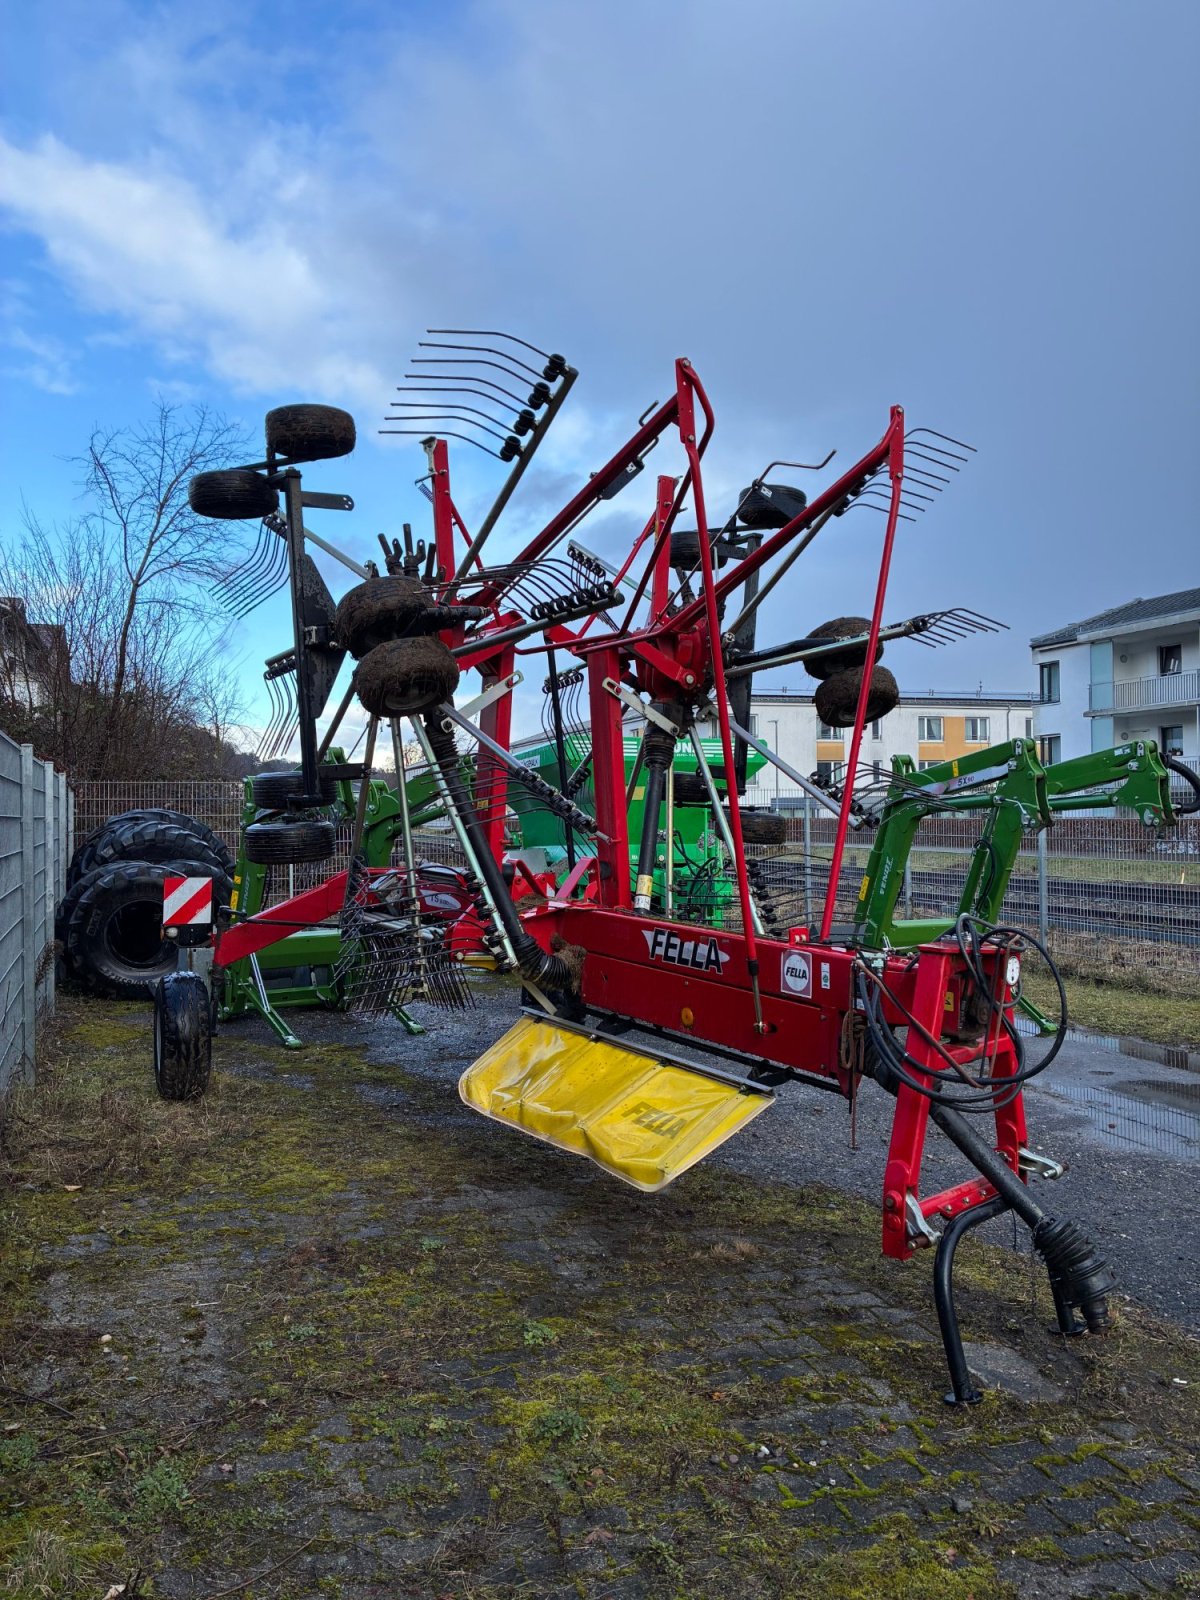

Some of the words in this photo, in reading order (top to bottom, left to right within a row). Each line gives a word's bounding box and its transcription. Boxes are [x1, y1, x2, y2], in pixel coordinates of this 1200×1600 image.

[649, 927, 723, 975] FELLA
[785, 966, 808, 980] FELLA
[621, 1101, 687, 1140] FELLA
